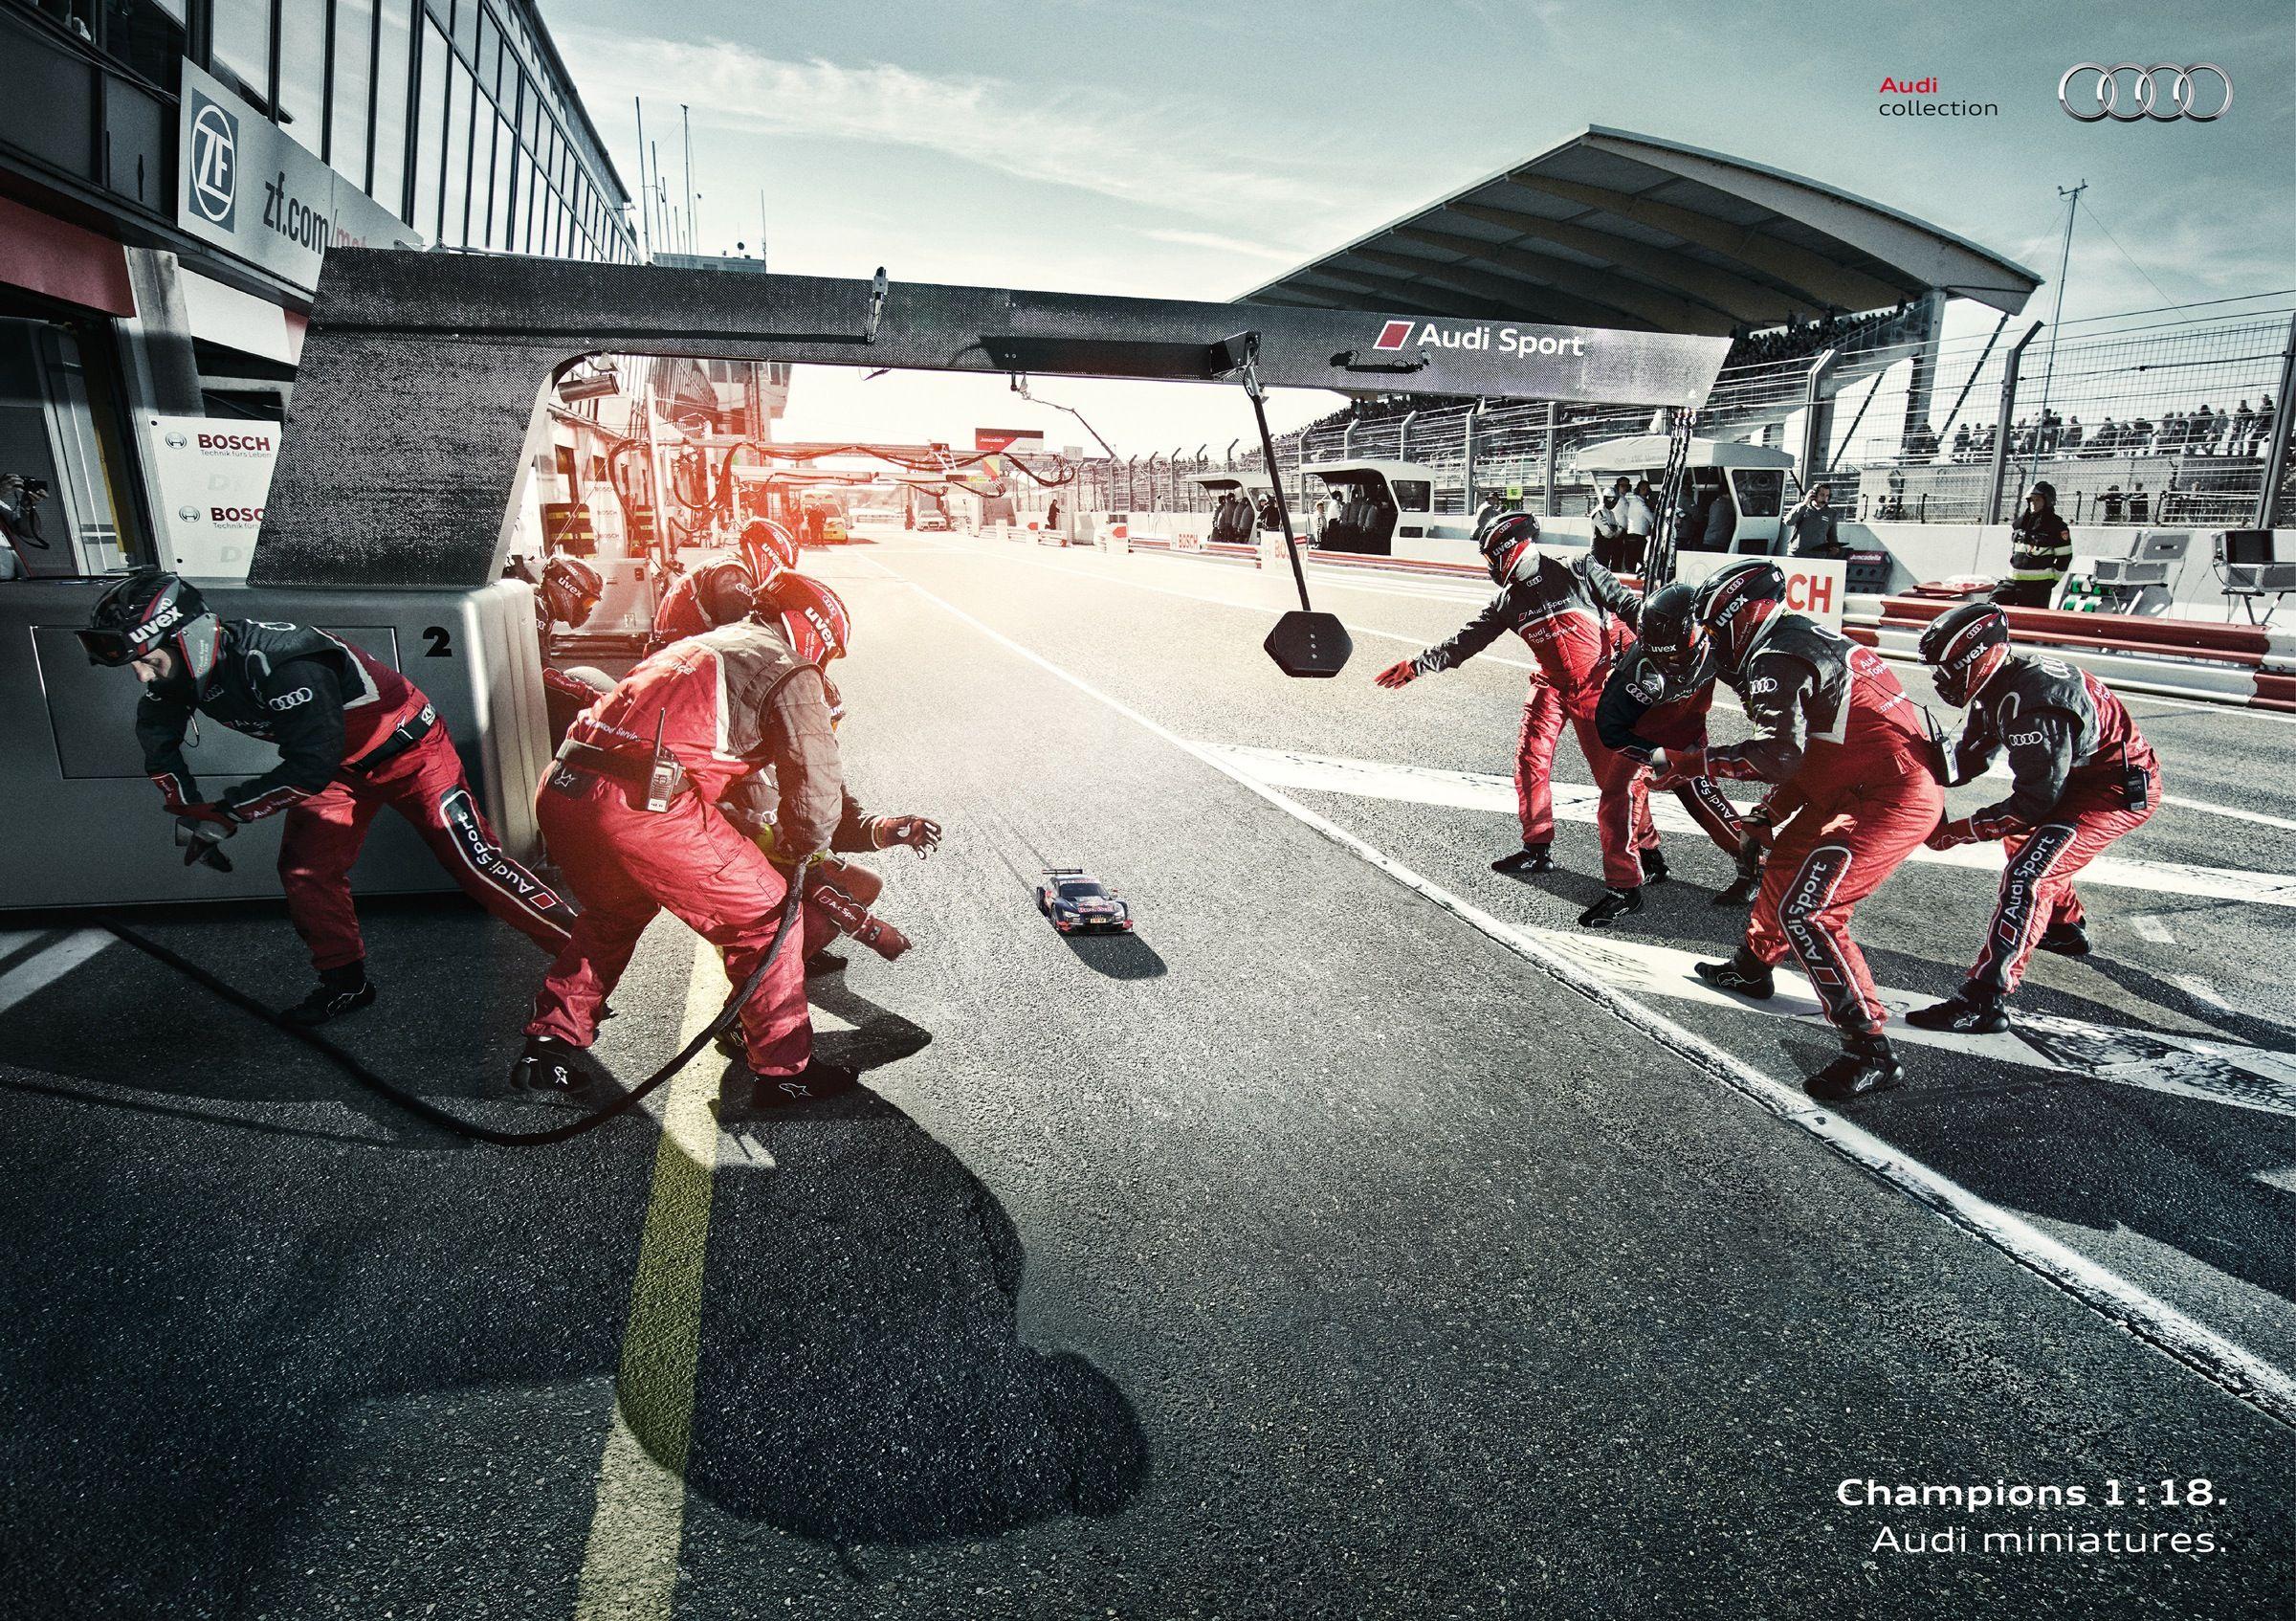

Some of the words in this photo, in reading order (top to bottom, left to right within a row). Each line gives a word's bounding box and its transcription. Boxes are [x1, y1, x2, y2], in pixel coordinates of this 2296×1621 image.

[194, 122, 233, 205] ZF
[1417, 323, 1490, 350] Audi
[1498, 328, 1585, 358] Sport
[198, 433, 271, 452] BOSCH
[210, 507, 265, 522] BOSC
[1179, 533, 1198, 549] BOSCH
[1492, 537, 1518, 557] uvex
[558, 576, 584, 598] uvex
[1786, 573, 1833, 613] CH
[1548, 597, 1572, 611] Sport
[1715, 594, 1749, 628] uvex
[128, 606, 184, 644] uvex
[805, 606, 837, 652] uvex
[1528, 627, 1546, 640] Audi
[1531, 634, 1545, 644] Top
[422, 627, 453, 657] 2
[1651, 644, 1677, 653] uvex
[1953, 642, 1988, 670] uvex
[1709, 793, 1734, 818] Audi
[457, 811, 494, 865] Sport
[2013, 835, 2056, 877] Sport
[488, 860, 536, 894] Audi
[1788, 861, 1827, 915] Sport
[2004, 880, 2025, 920] Audi
[1788, 919, 1823, 961] Audi
